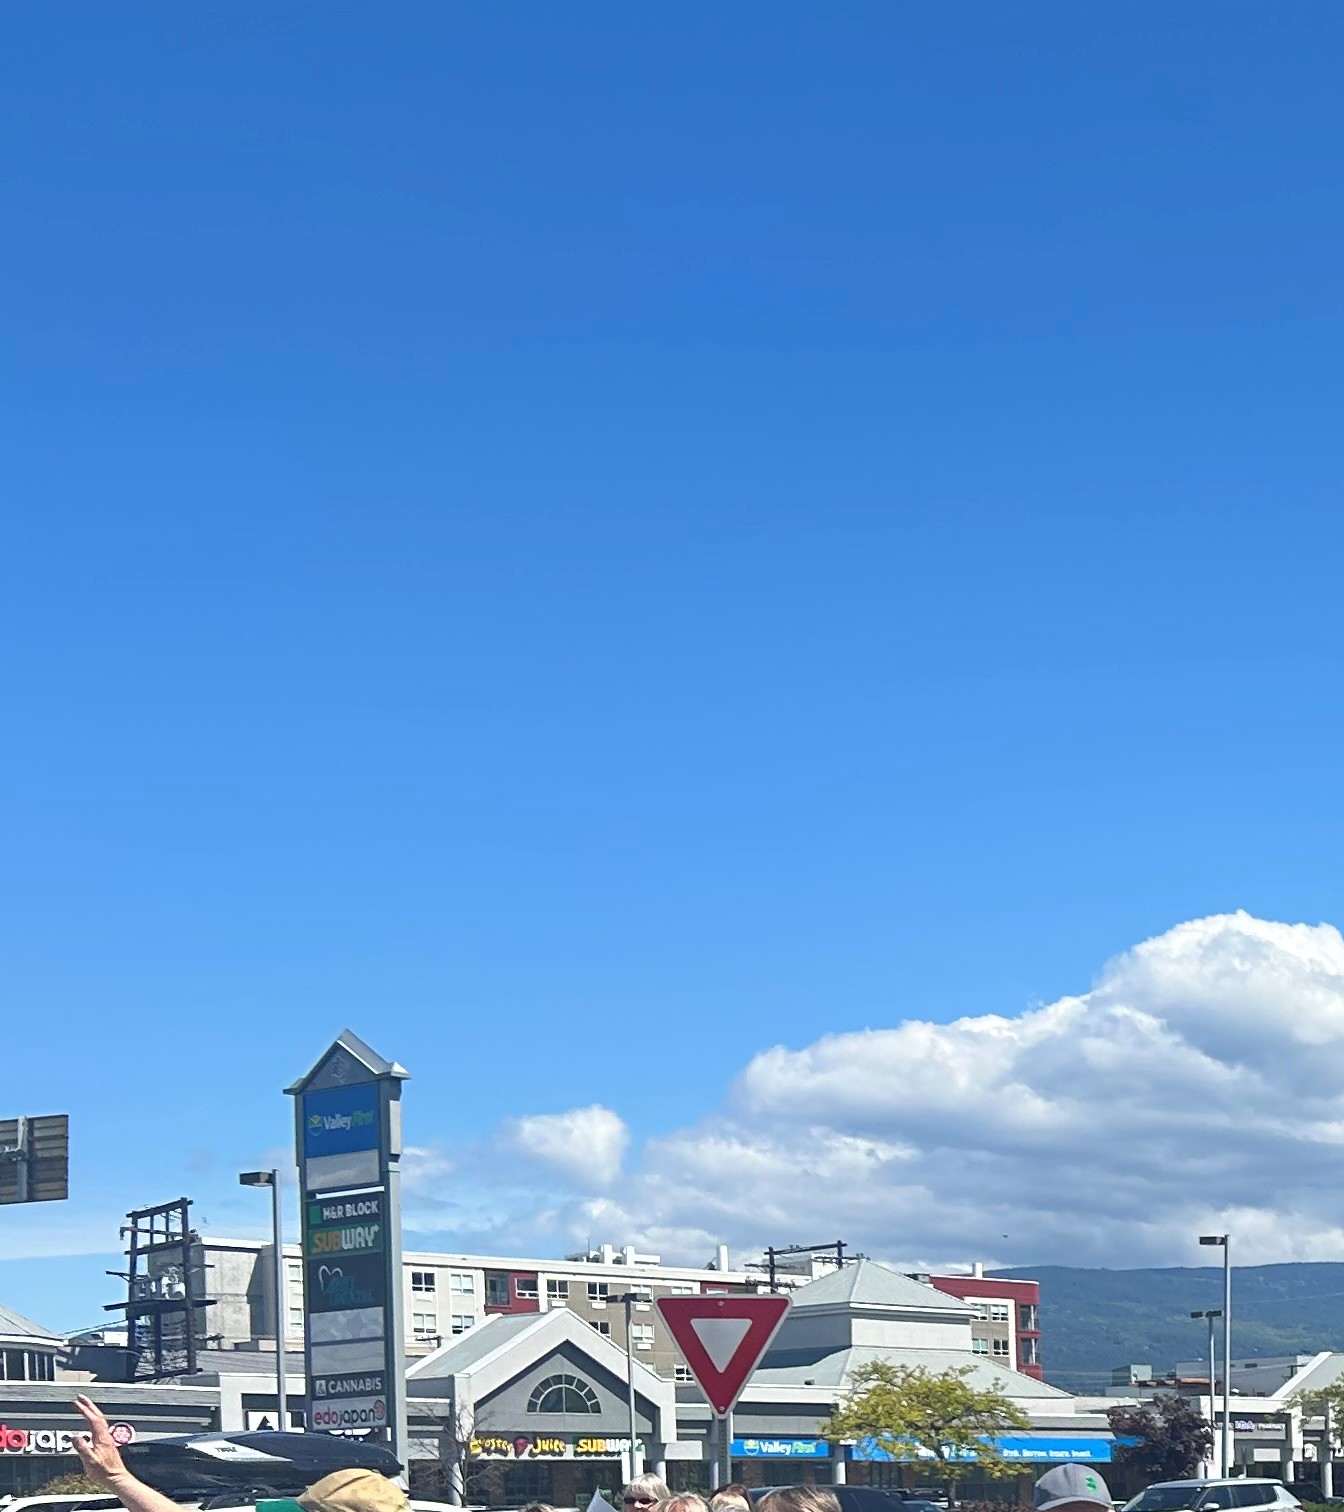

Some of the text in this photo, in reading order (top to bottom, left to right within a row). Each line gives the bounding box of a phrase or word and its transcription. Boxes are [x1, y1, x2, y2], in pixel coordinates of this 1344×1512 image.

[324, 1113, 353, 1131] Valley
[323, 1200, 379, 1220] H&R BLOCK
[312, 1224, 379, 1254] SUBWAY
[328, 1377, 382, 1394] CANNABIS
[531, 1435, 567, 1454] Juice
[760, 1440, 791, 1456] Valley
